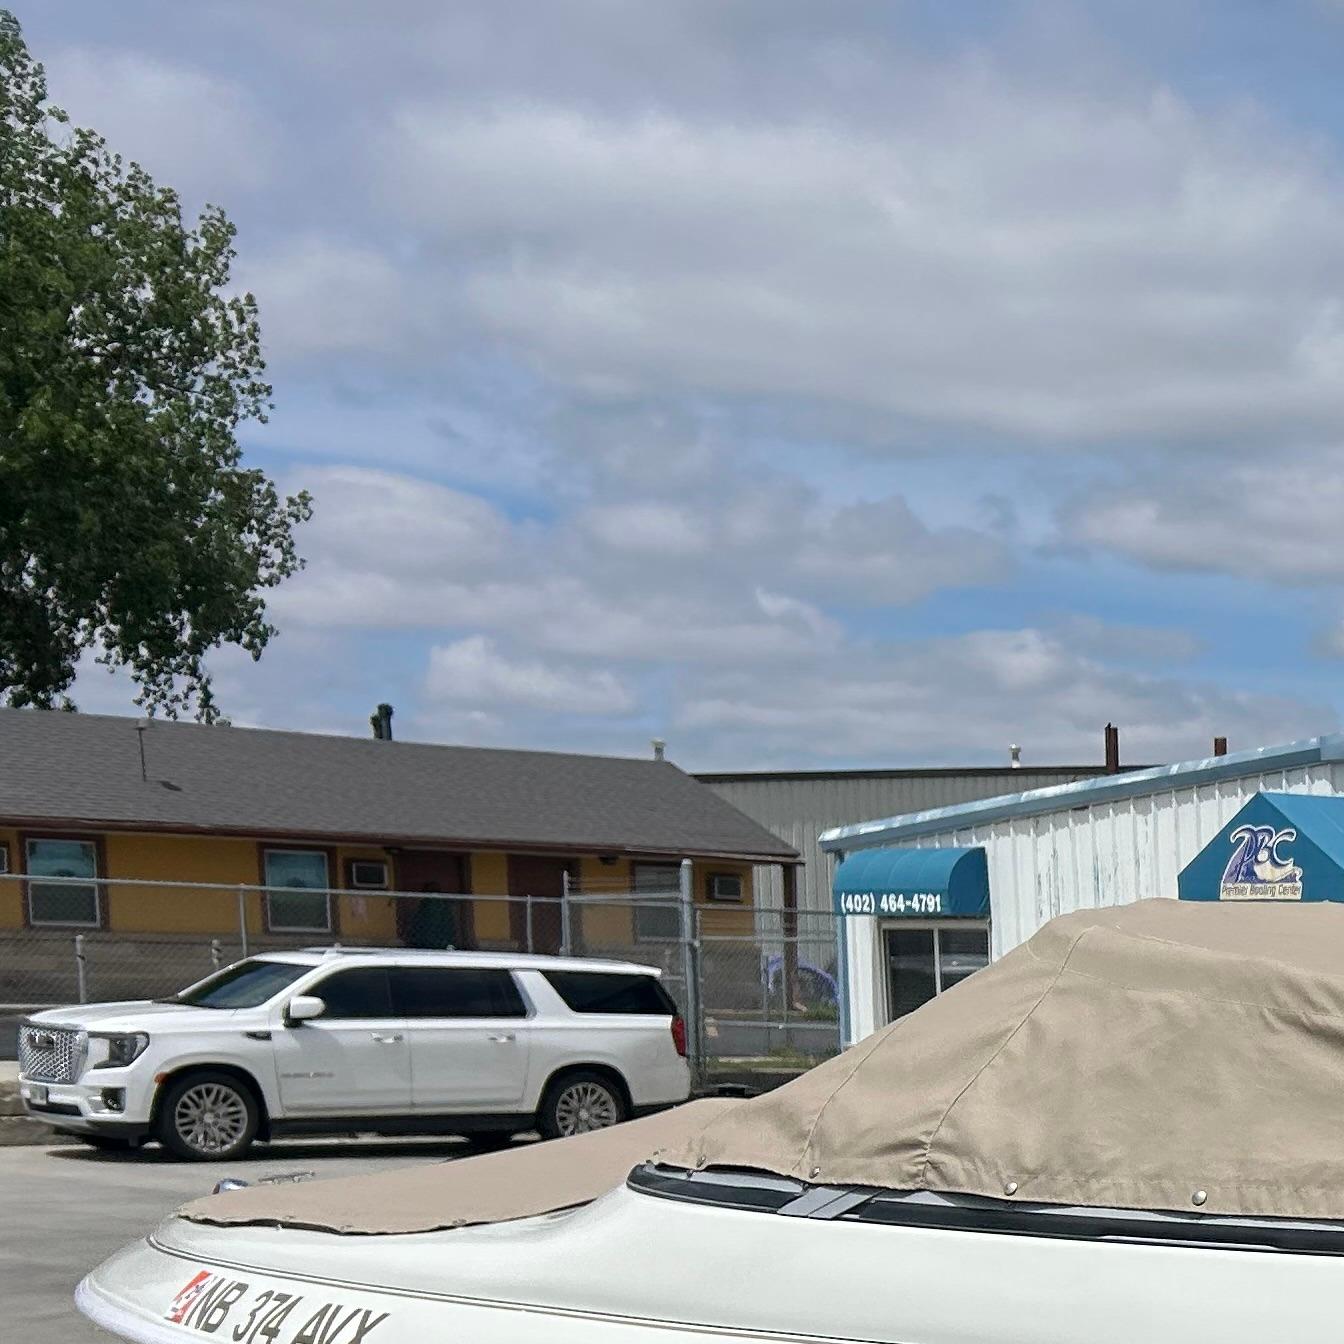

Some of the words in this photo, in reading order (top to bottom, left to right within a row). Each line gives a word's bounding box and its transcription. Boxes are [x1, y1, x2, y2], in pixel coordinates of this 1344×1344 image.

[841, 892, 875, 914] (402)
[880, 893, 941, 913] 464-4791
[184, 1277, 249, 1334] NB
